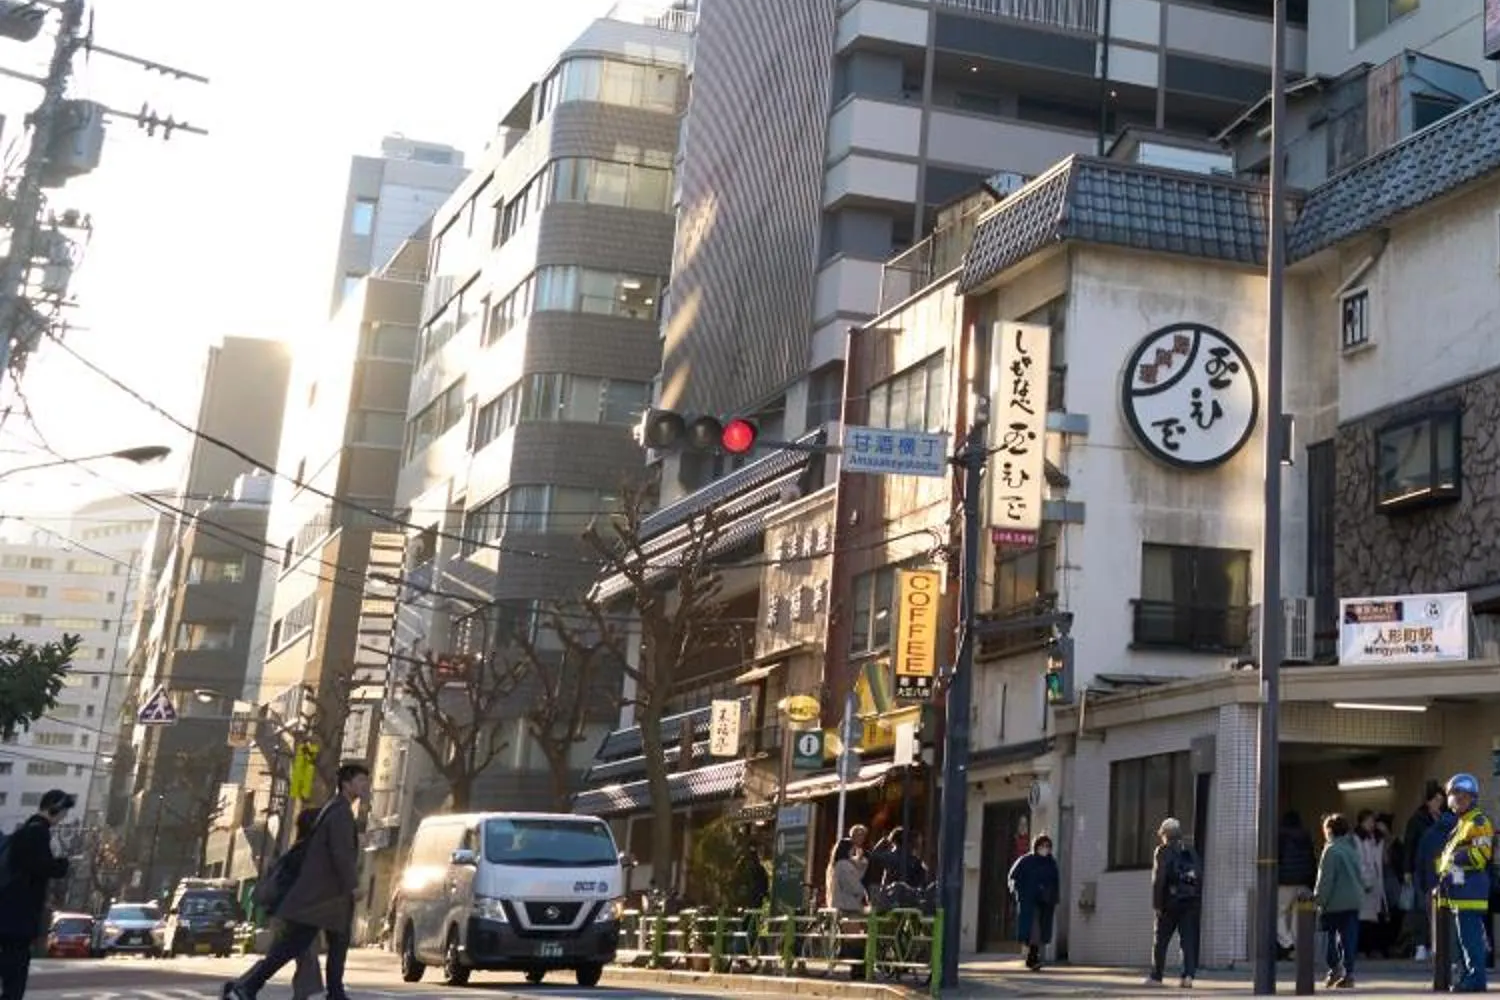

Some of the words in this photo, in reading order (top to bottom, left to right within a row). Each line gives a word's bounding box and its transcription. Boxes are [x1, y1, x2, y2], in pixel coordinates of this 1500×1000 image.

[851, 431, 939, 457] 甘酒横丁
[906, 575, 930, 672] COFFEE
[1372, 627, 1433, 645] 人形町駅
